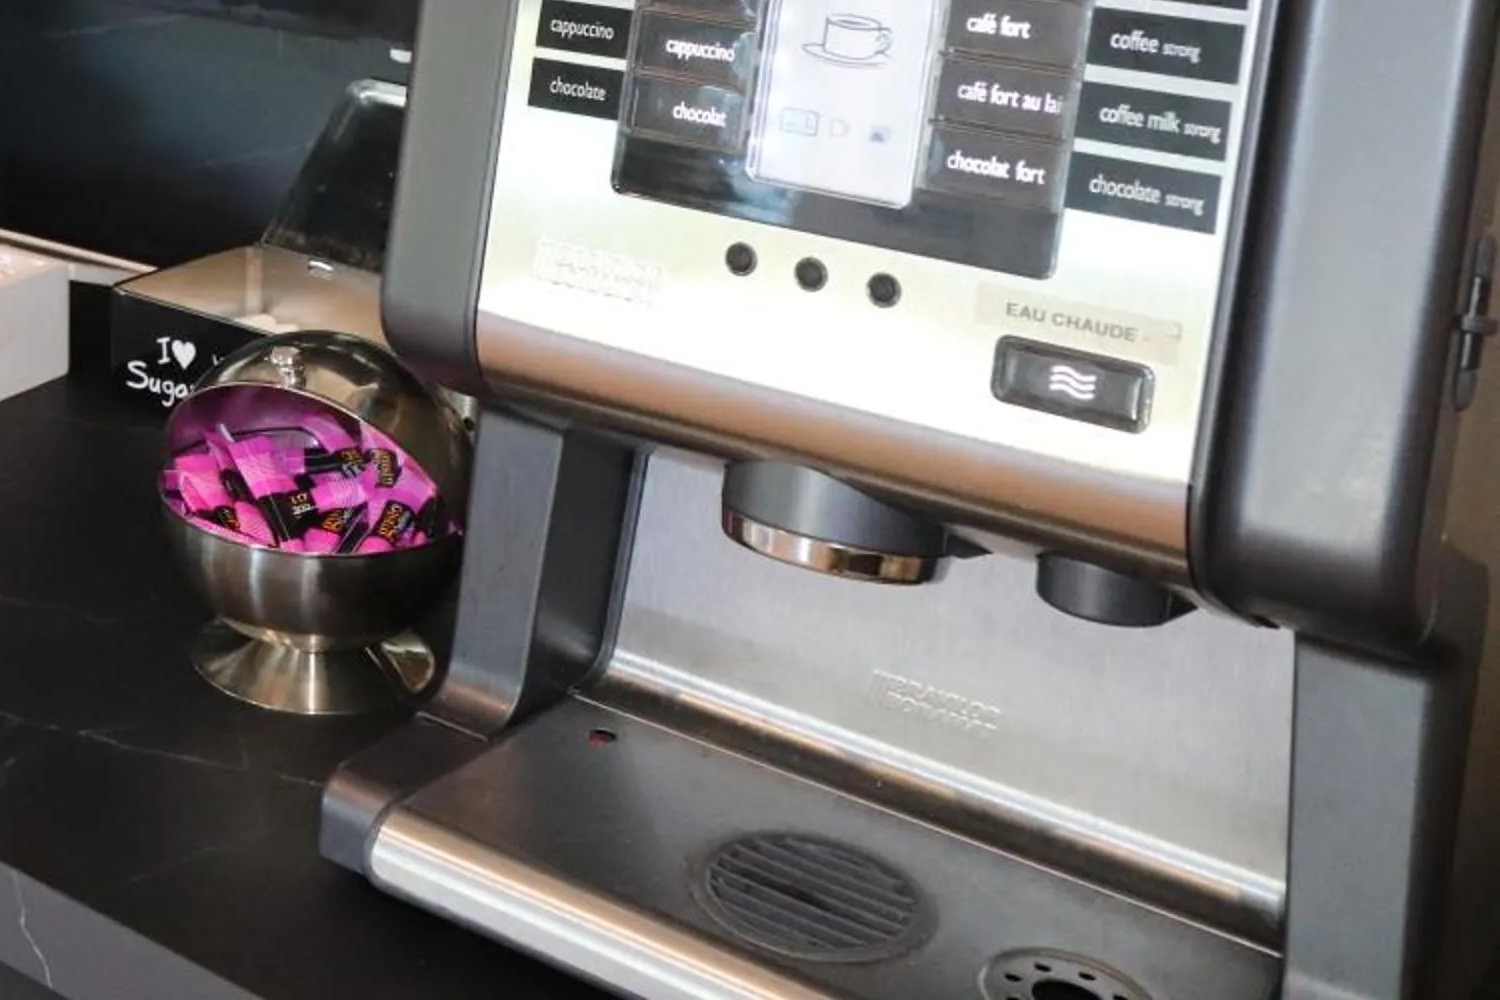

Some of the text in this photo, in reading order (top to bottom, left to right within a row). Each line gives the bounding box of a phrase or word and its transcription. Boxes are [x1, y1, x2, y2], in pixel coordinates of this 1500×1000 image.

[550, 18, 614, 41] cappuccino
[966, 13, 1030, 39] café fort
[666, 40, 735, 62] cappuccino
[1110, 30, 1201, 64] coffee strong
[550, 77, 606, 101] chocolate
[957, 81, 988, 102] café
[991, 84, 1020, 108] fort
[1022, 94, 1041, 111] au
[1099, 104, 1221, 144] coffee milk strong
[947, 150, 1046, 185] chocolat fort
[1089, 175, 1204, 216] chocolate strong
[1005, 301, 1139, 343] EAU CHAUDE
[156, 336, 171, 365] I
